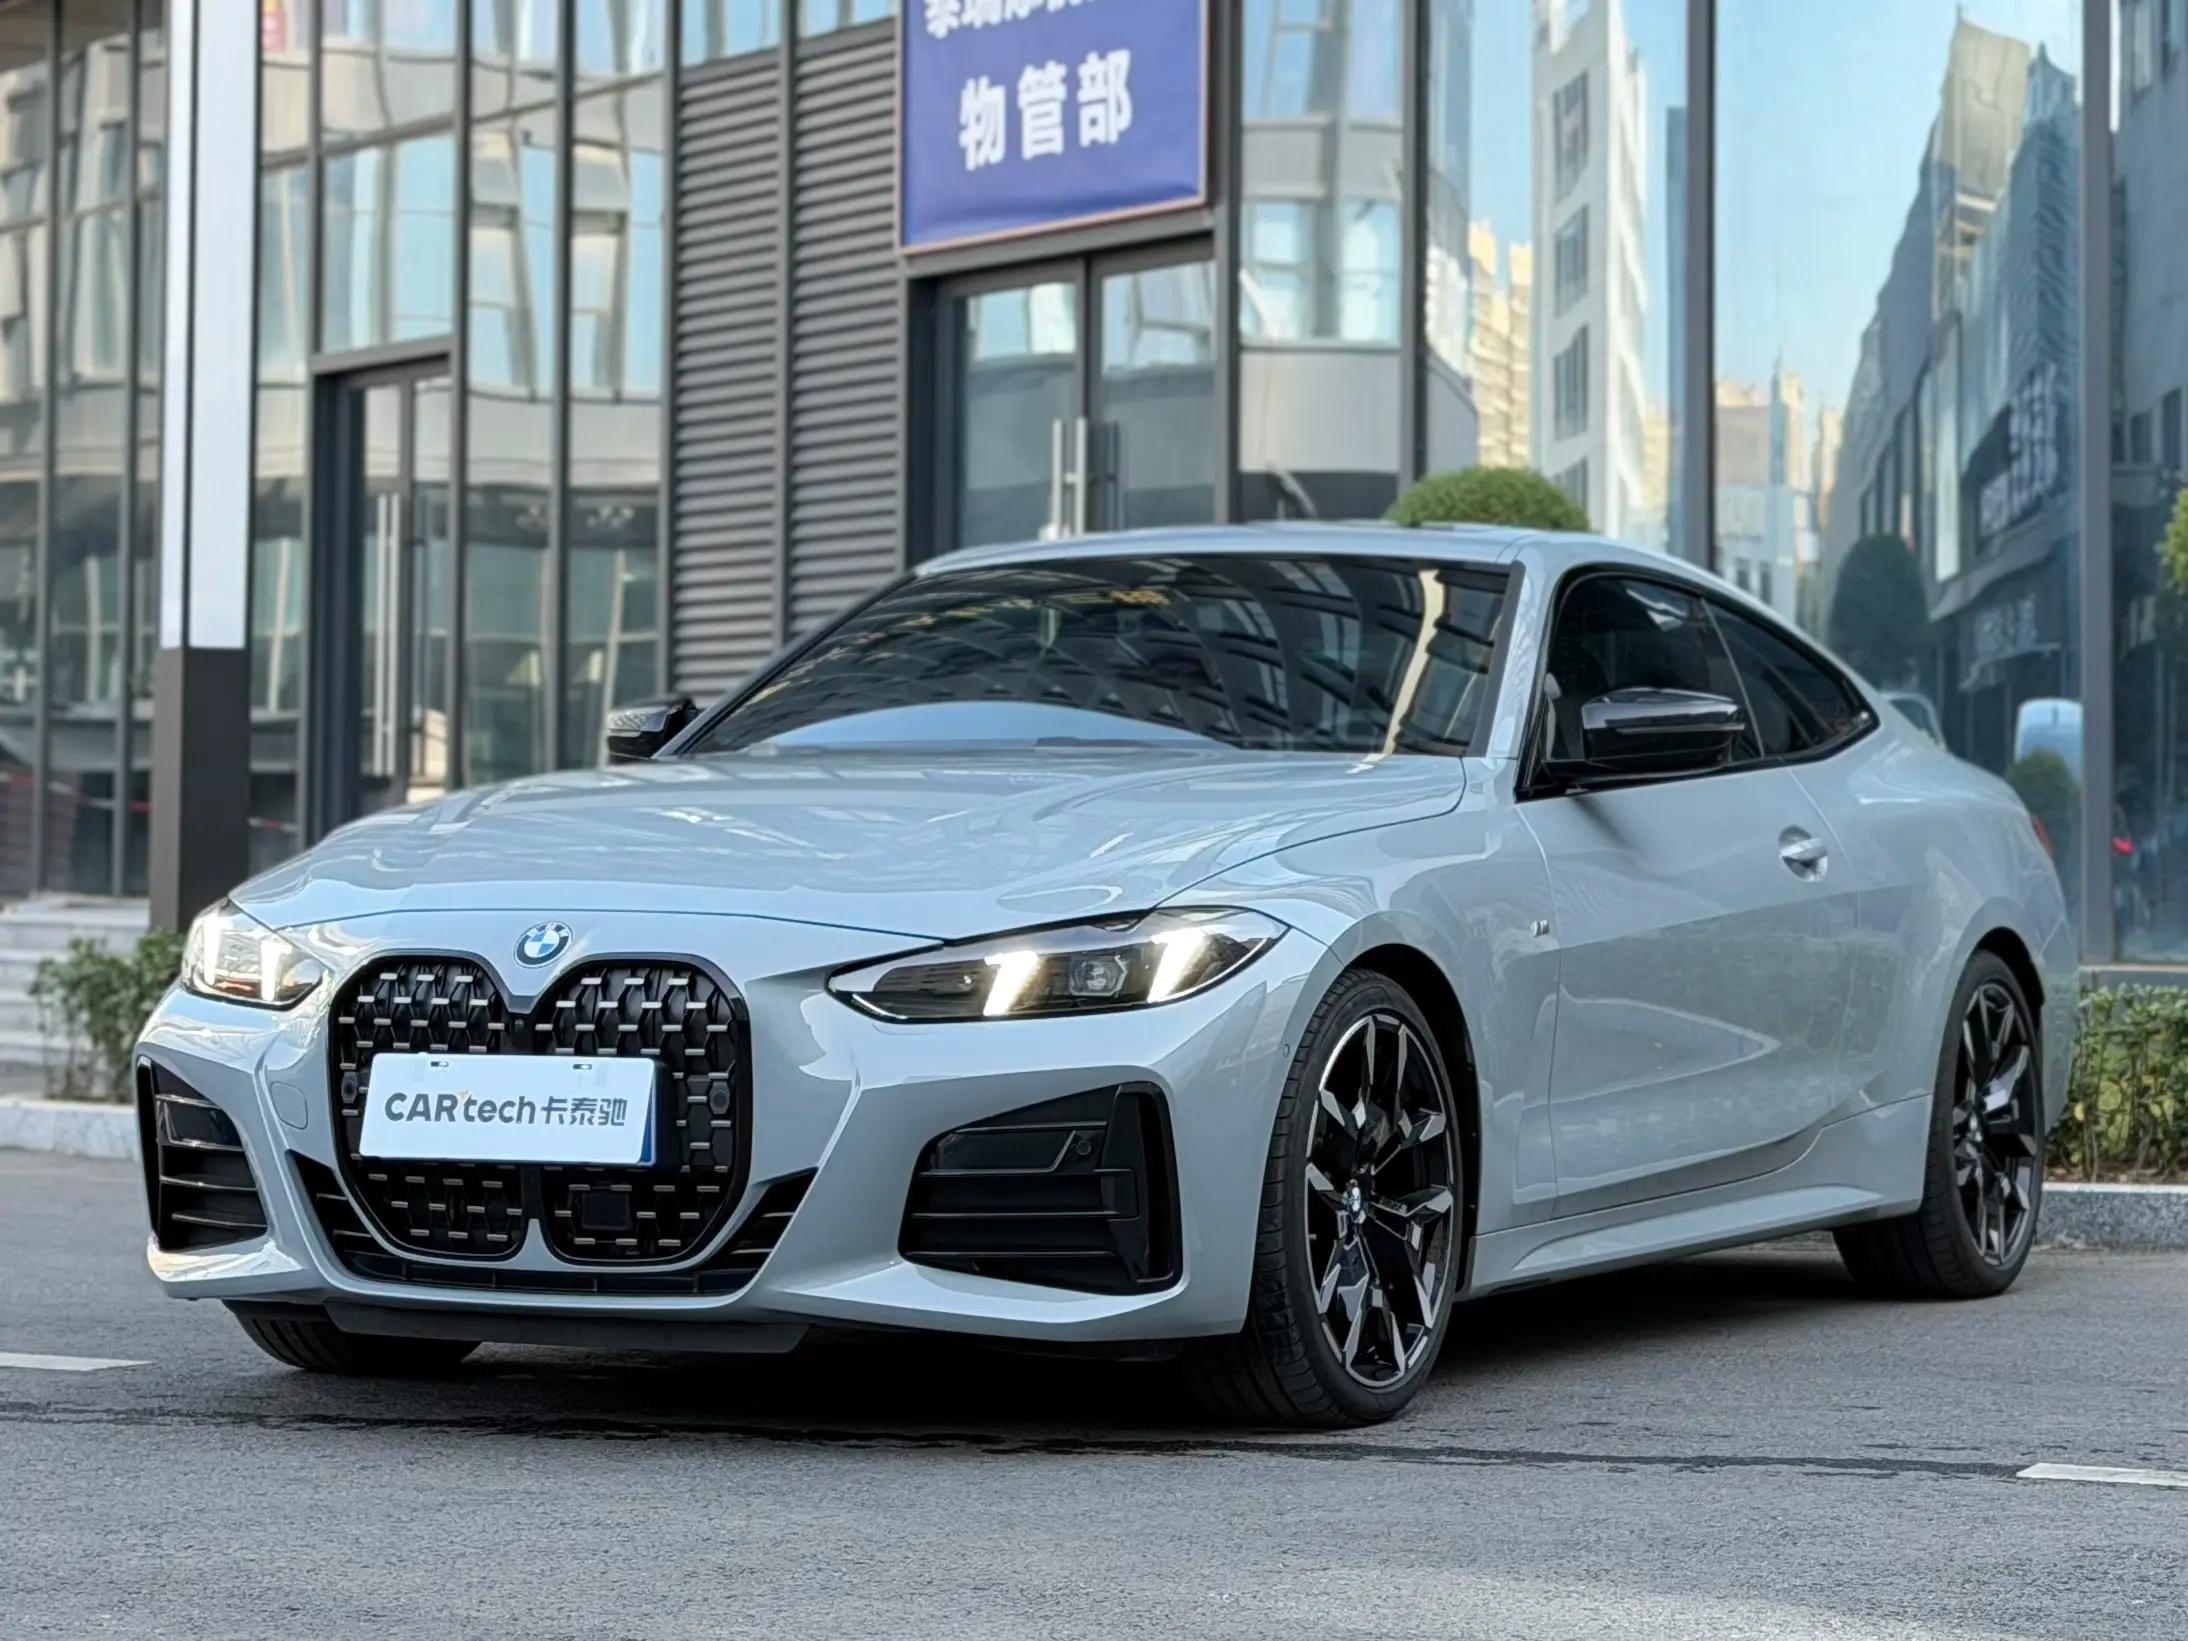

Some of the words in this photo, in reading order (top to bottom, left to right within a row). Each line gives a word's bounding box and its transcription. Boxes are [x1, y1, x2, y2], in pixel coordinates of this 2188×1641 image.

[959, 49, 1131, 170] 物管部
[385, 1092, 535, 1124] CARtech
[541, 1096, 627, 1126] 卡泰驰
